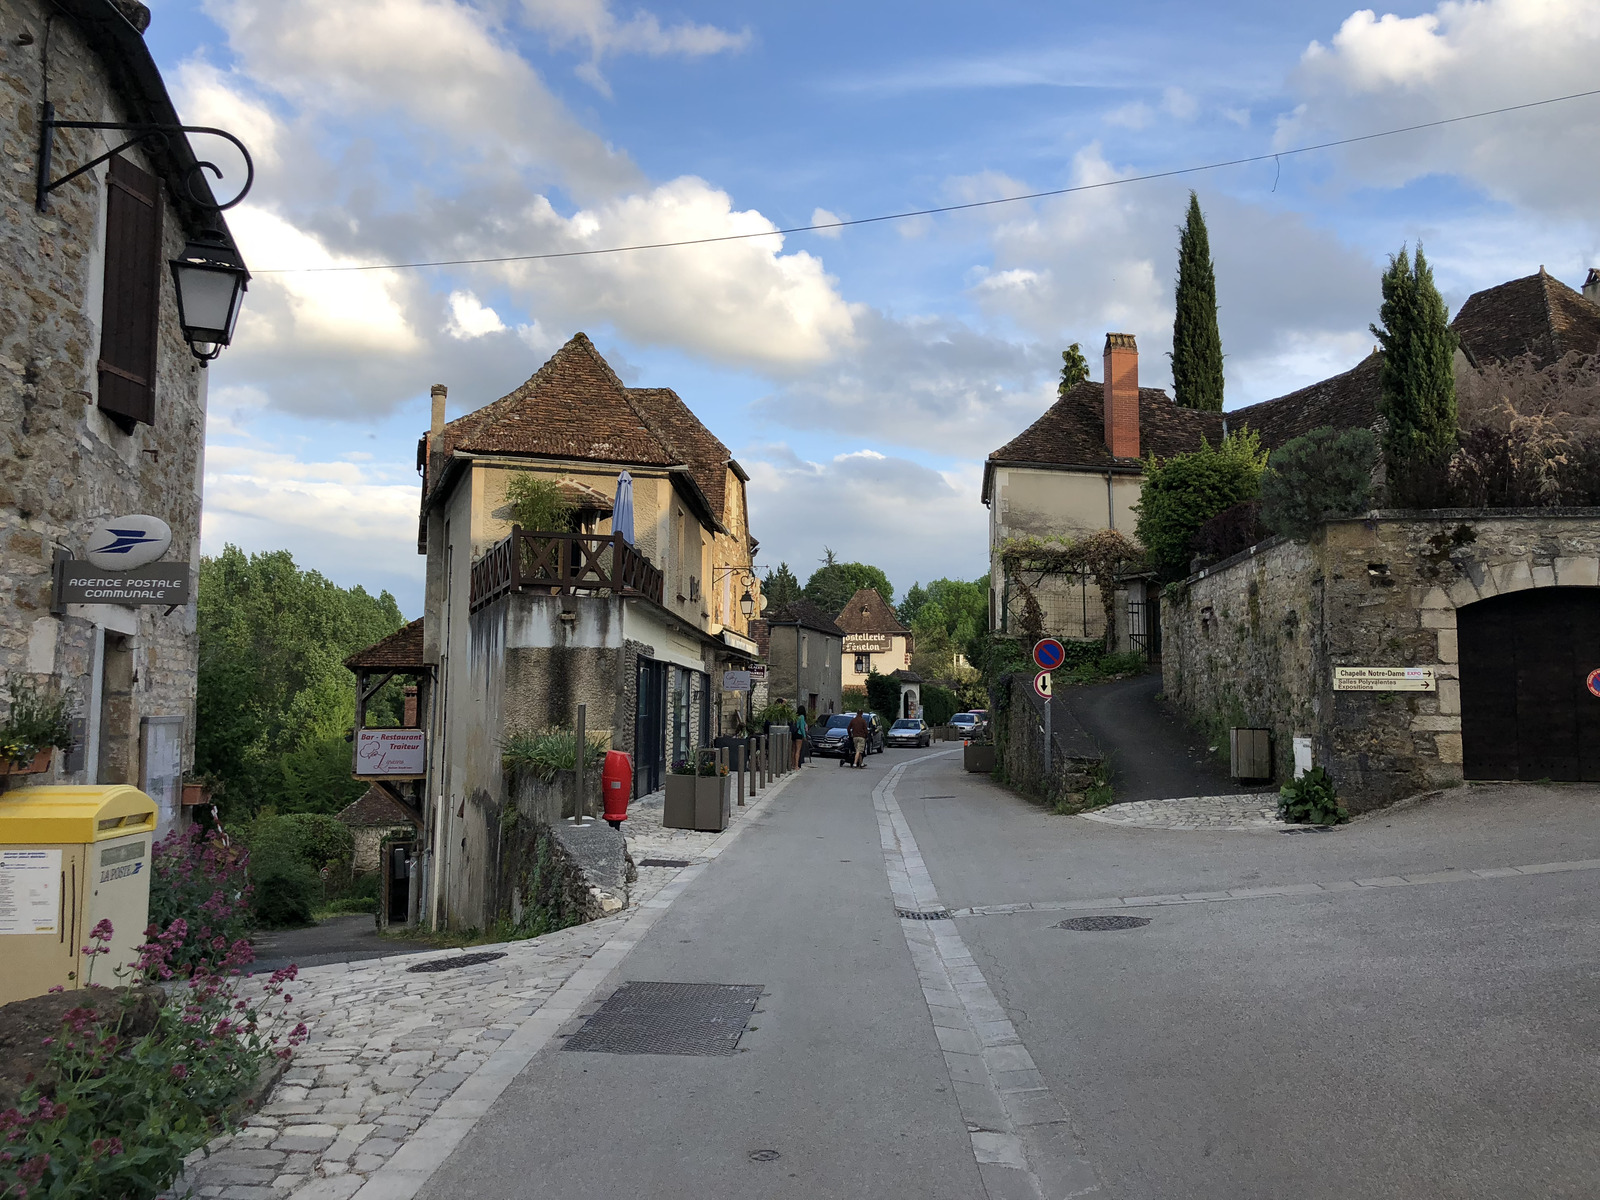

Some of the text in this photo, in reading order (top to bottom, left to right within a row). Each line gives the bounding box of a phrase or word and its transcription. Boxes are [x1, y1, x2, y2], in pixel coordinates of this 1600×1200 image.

[69, 578, 181, 588] AGENCE POSTALE
[85, 589, 165, 598] COMMUNALE
[99, 865, 131, 883] LA POSTE
